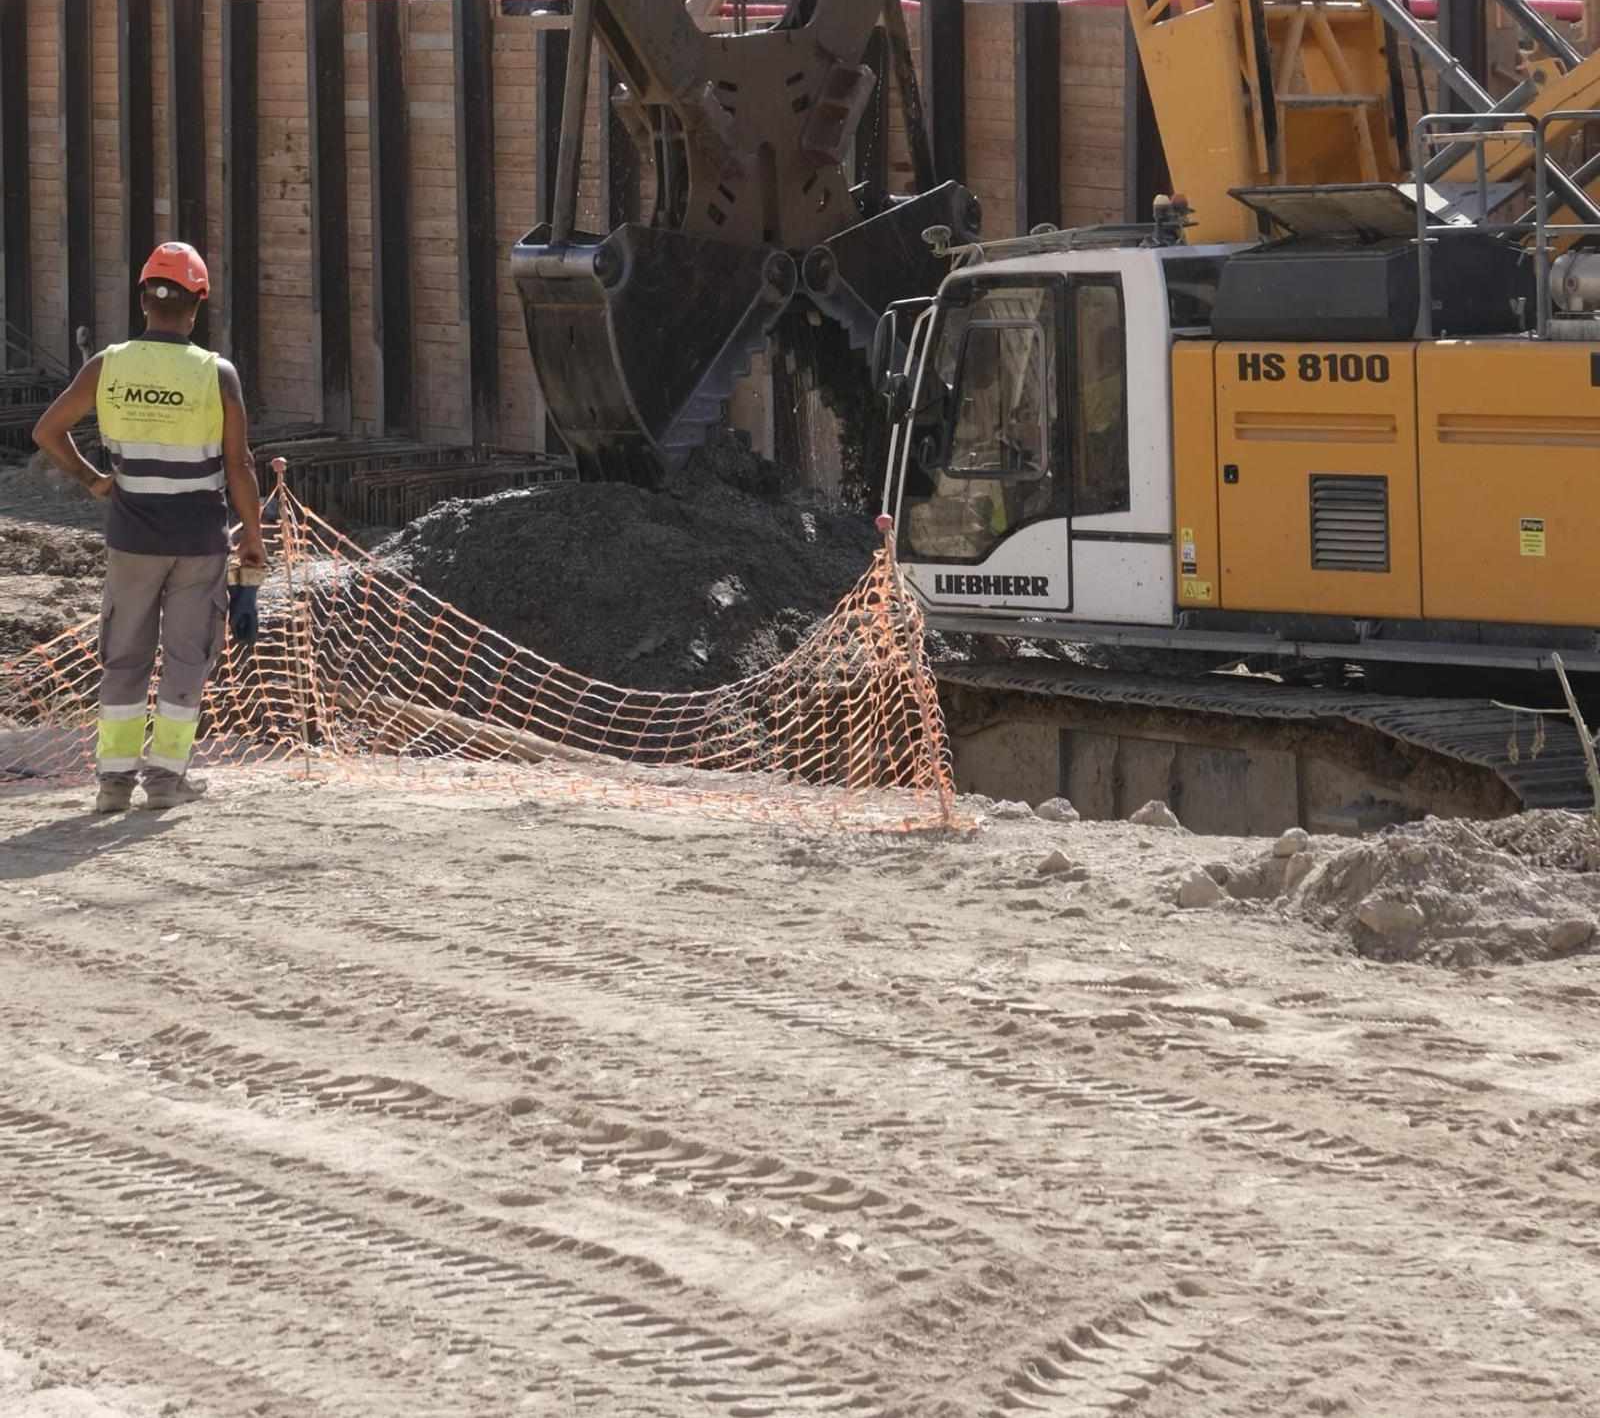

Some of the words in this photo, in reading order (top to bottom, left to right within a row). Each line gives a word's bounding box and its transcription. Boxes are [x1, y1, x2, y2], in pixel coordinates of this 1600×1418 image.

[1238, 353, 1286, 381] HS
[1298, 353, 1390, 383] 8100
[124, 388, 184, 406] MOZO
[935, 574, 1049, 597] LIEBHERR
